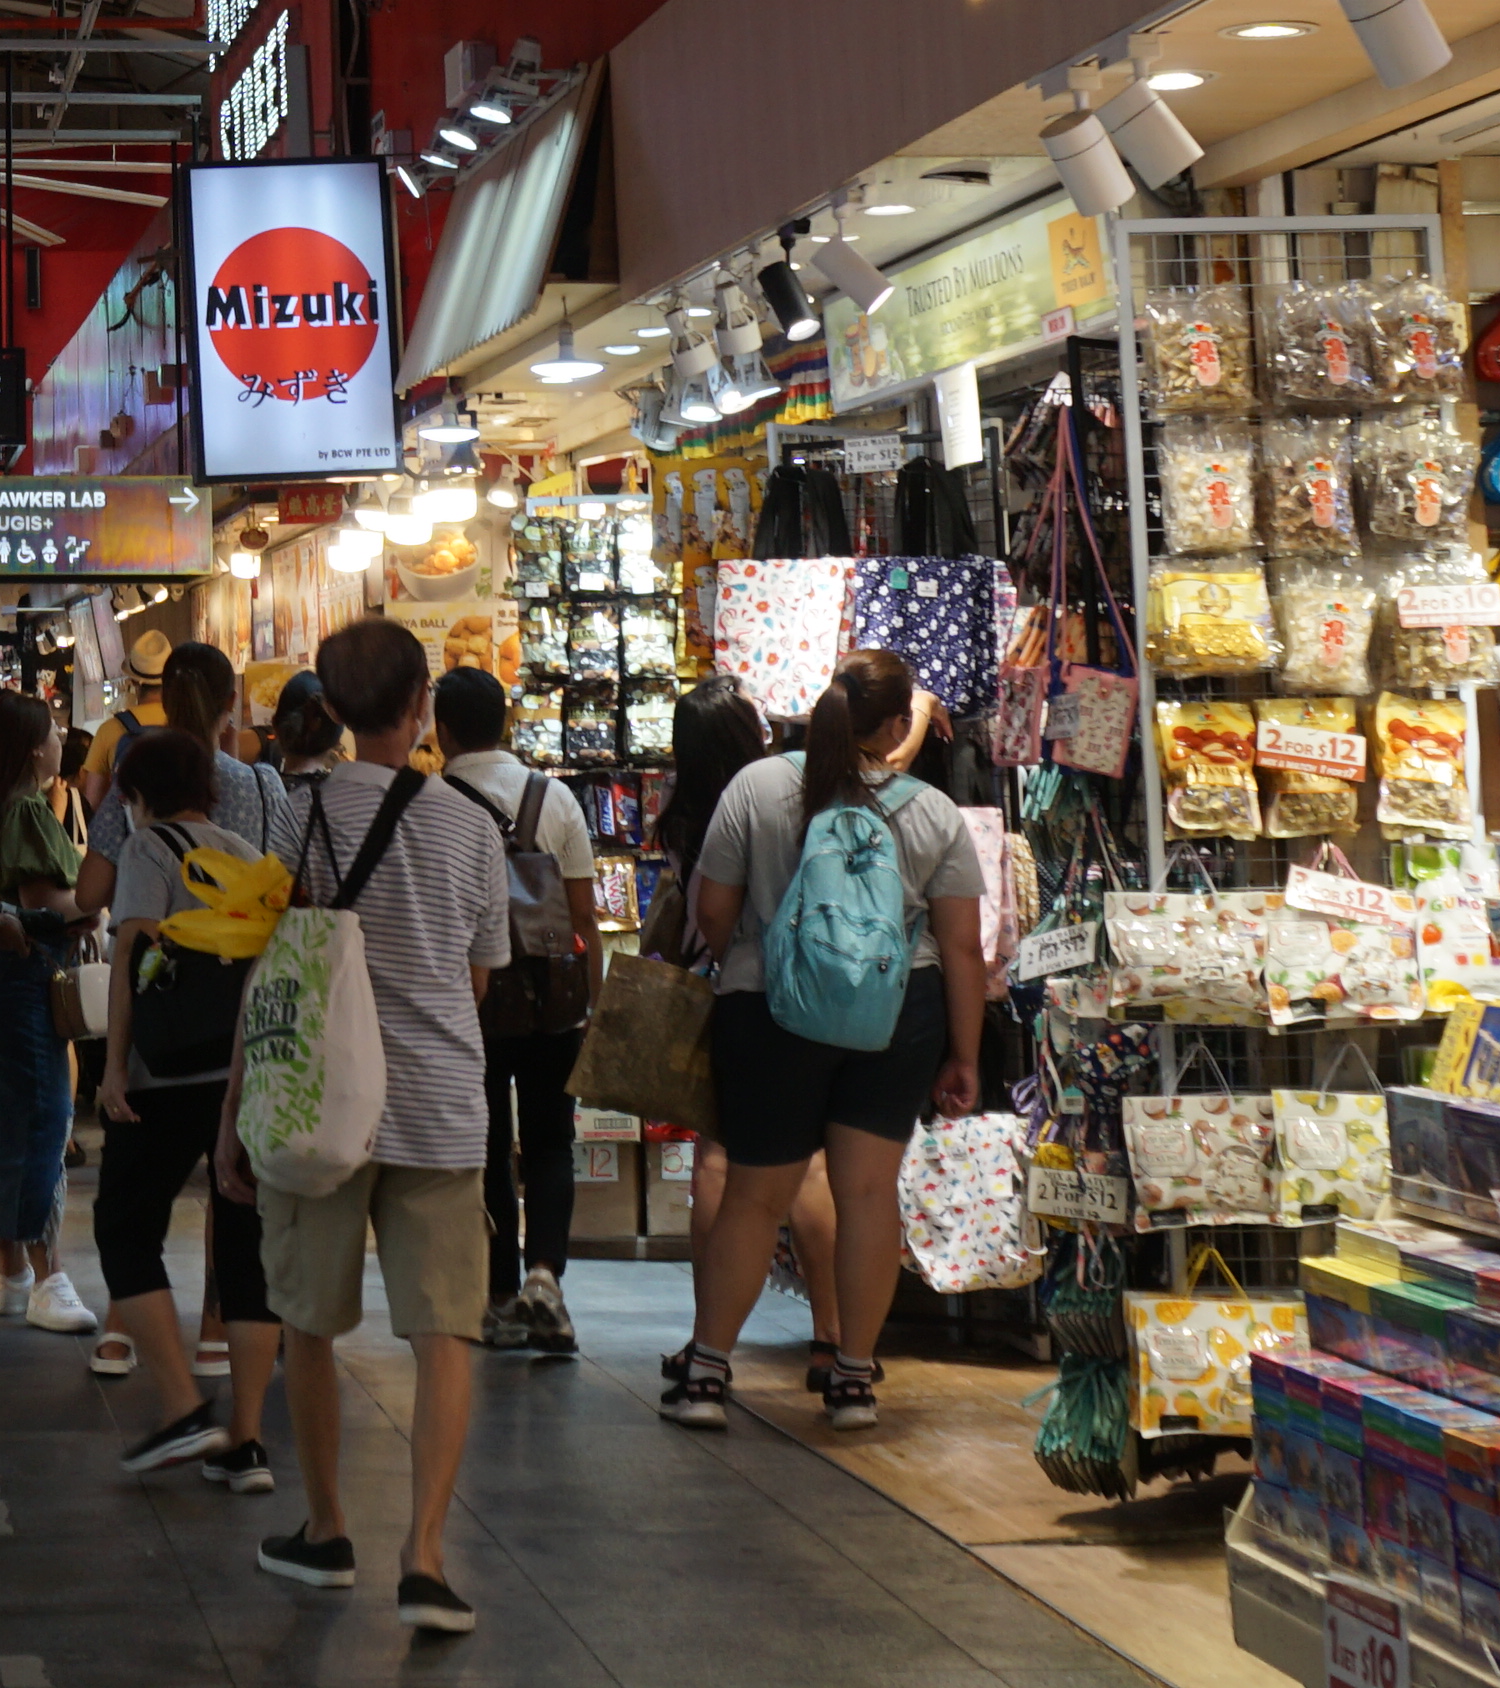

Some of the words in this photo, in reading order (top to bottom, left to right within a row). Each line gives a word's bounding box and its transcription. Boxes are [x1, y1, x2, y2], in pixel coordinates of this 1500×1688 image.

[905, 277, 951, 317] TRUSTED
[968, 245, 1025, 294] MILLIONS
[206, 280, 380, 331] Mizuki
[238, 369, 350, 409] みずき
[318, 449, 329, 460] by
[331, 450, 352, 458] BCW
[356, 449, 372, 457] PTE
[375, 448, 390, 456] LTD
[857, 450, 877, 461] For
[70, 491, 107, 509] LAB
[1401, 589, 1418, 611] 2
[1421, 596, 1449, 609] FOR
[1453, 587, 1497, 610] $10
[420, 618, 449, 629] BALL
[1264, 729, 1282, 750] 2
[1285, 739, 1313, 755] FOR
[1318, 737, 1357, 763] $12
[1345, 886, 1385, 912] $12
[1027, 952, 1034, 965] 2
[1038, 1183, 1047, 1200] 2
[1053, 1187, 1076, 1202] For
[1361, 1635, 1397, 1688] $10
